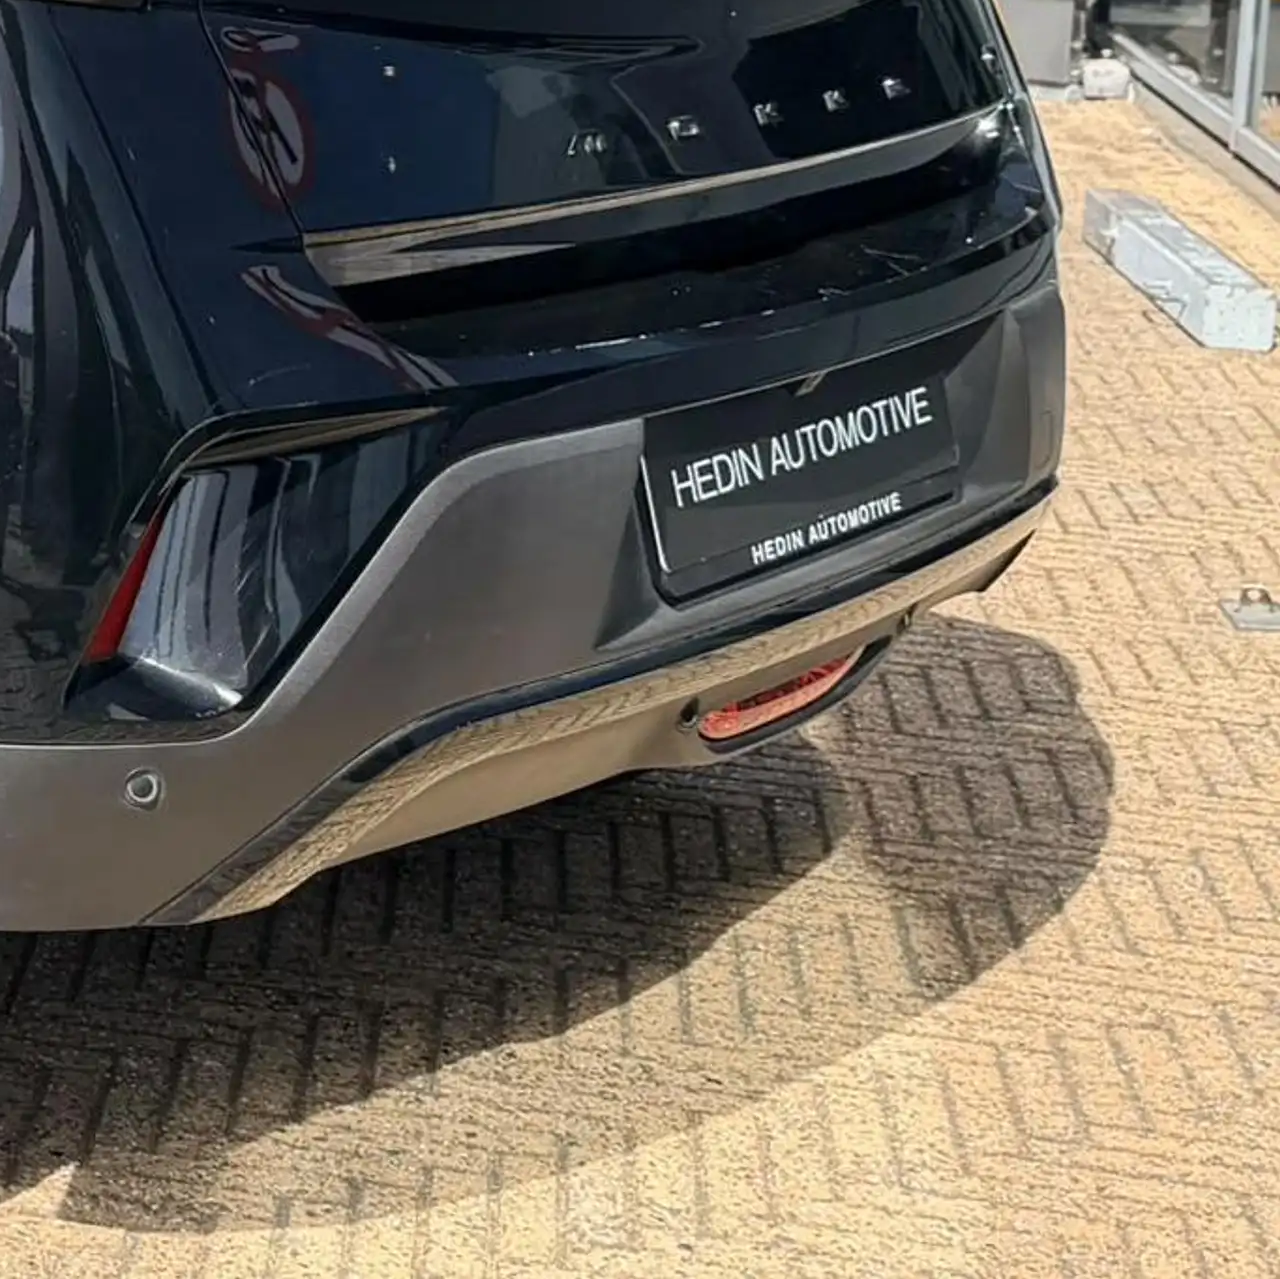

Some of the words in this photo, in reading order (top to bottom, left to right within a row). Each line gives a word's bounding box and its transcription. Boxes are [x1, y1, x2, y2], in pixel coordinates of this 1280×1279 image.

[670, 441, 765, 508] HEDIN
[770, 385, 933, 476] AUTOMOTIVE
[750, 530, 805, 565] HEDIN
[808, 491, 903, 546] AUTOMOTIVE
